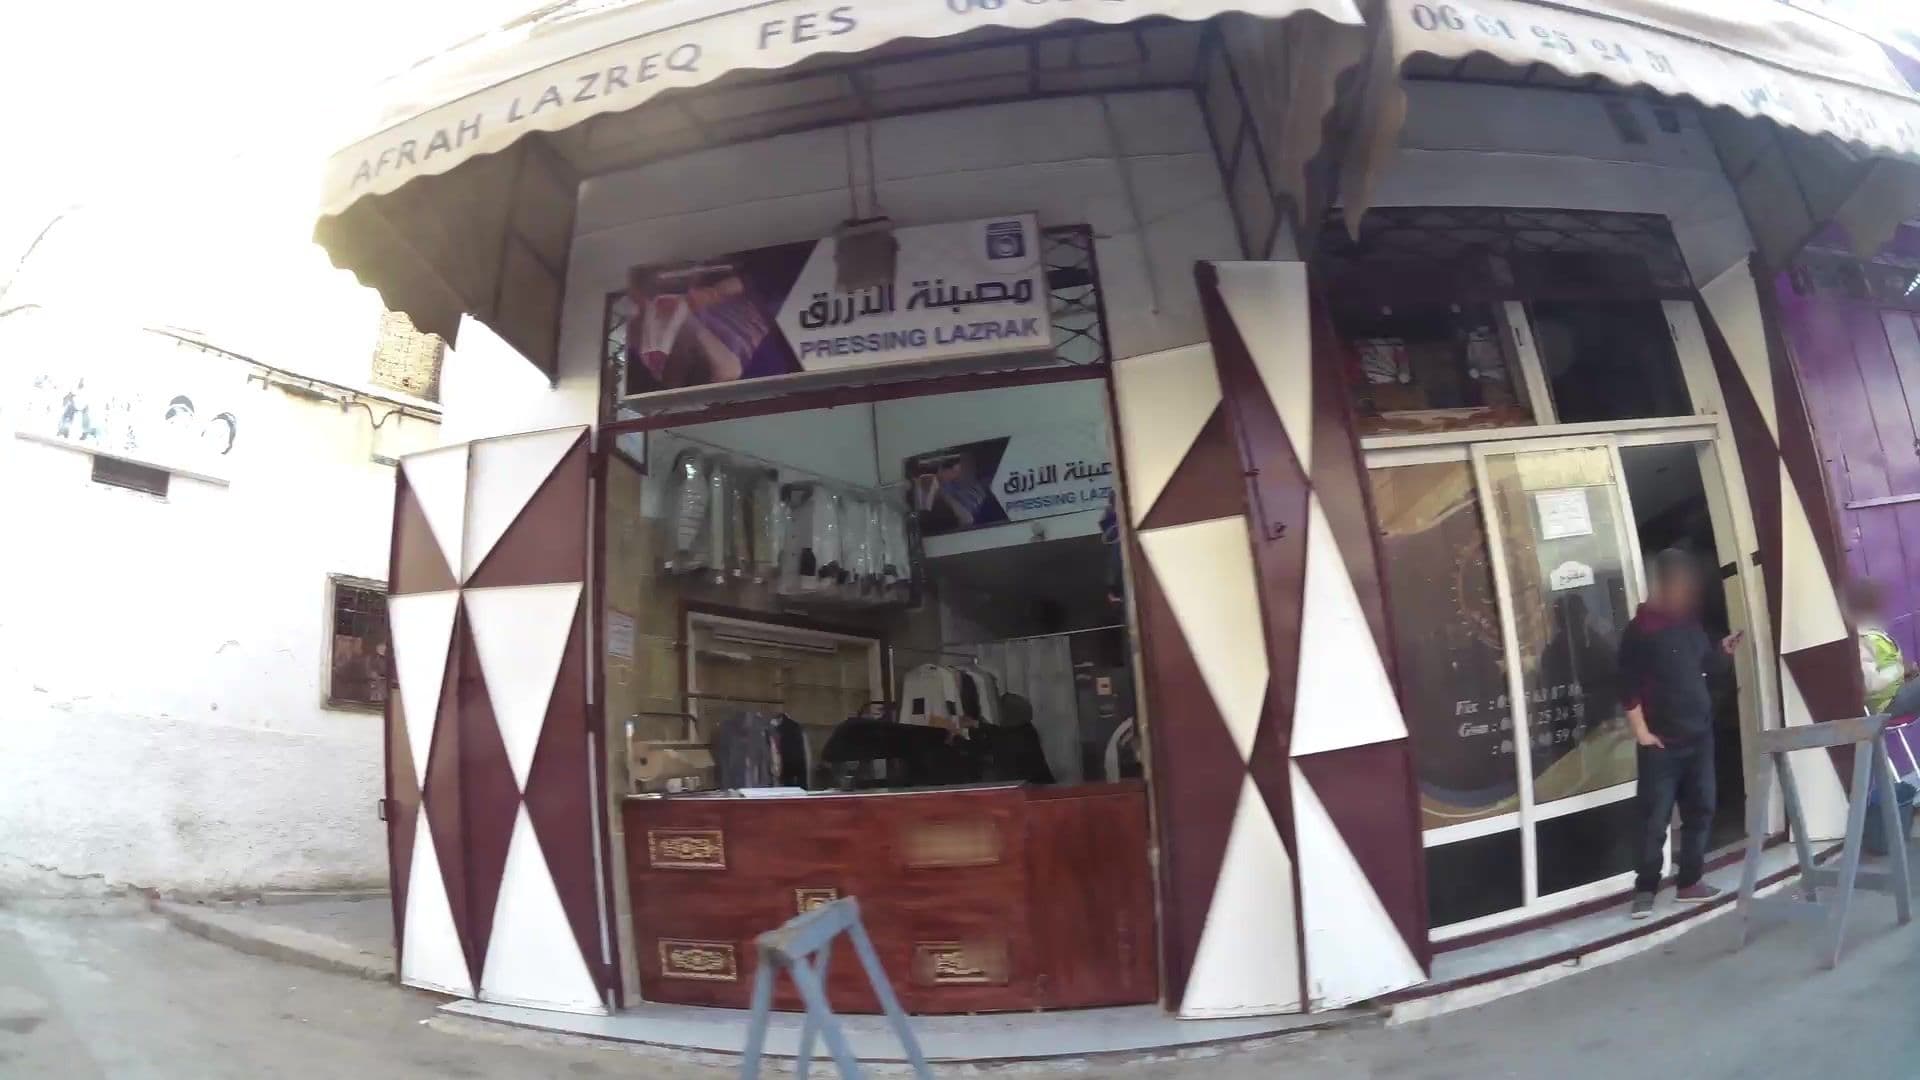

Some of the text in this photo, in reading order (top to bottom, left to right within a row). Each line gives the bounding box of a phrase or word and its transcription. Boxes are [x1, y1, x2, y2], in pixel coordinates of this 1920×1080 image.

[350, 6, 857, 190] AFRAH LAZREQ FES
[906, 279, 1032, 314] مصبنة
[800, 318, 1039, 359] PRESSING LAZRAK
